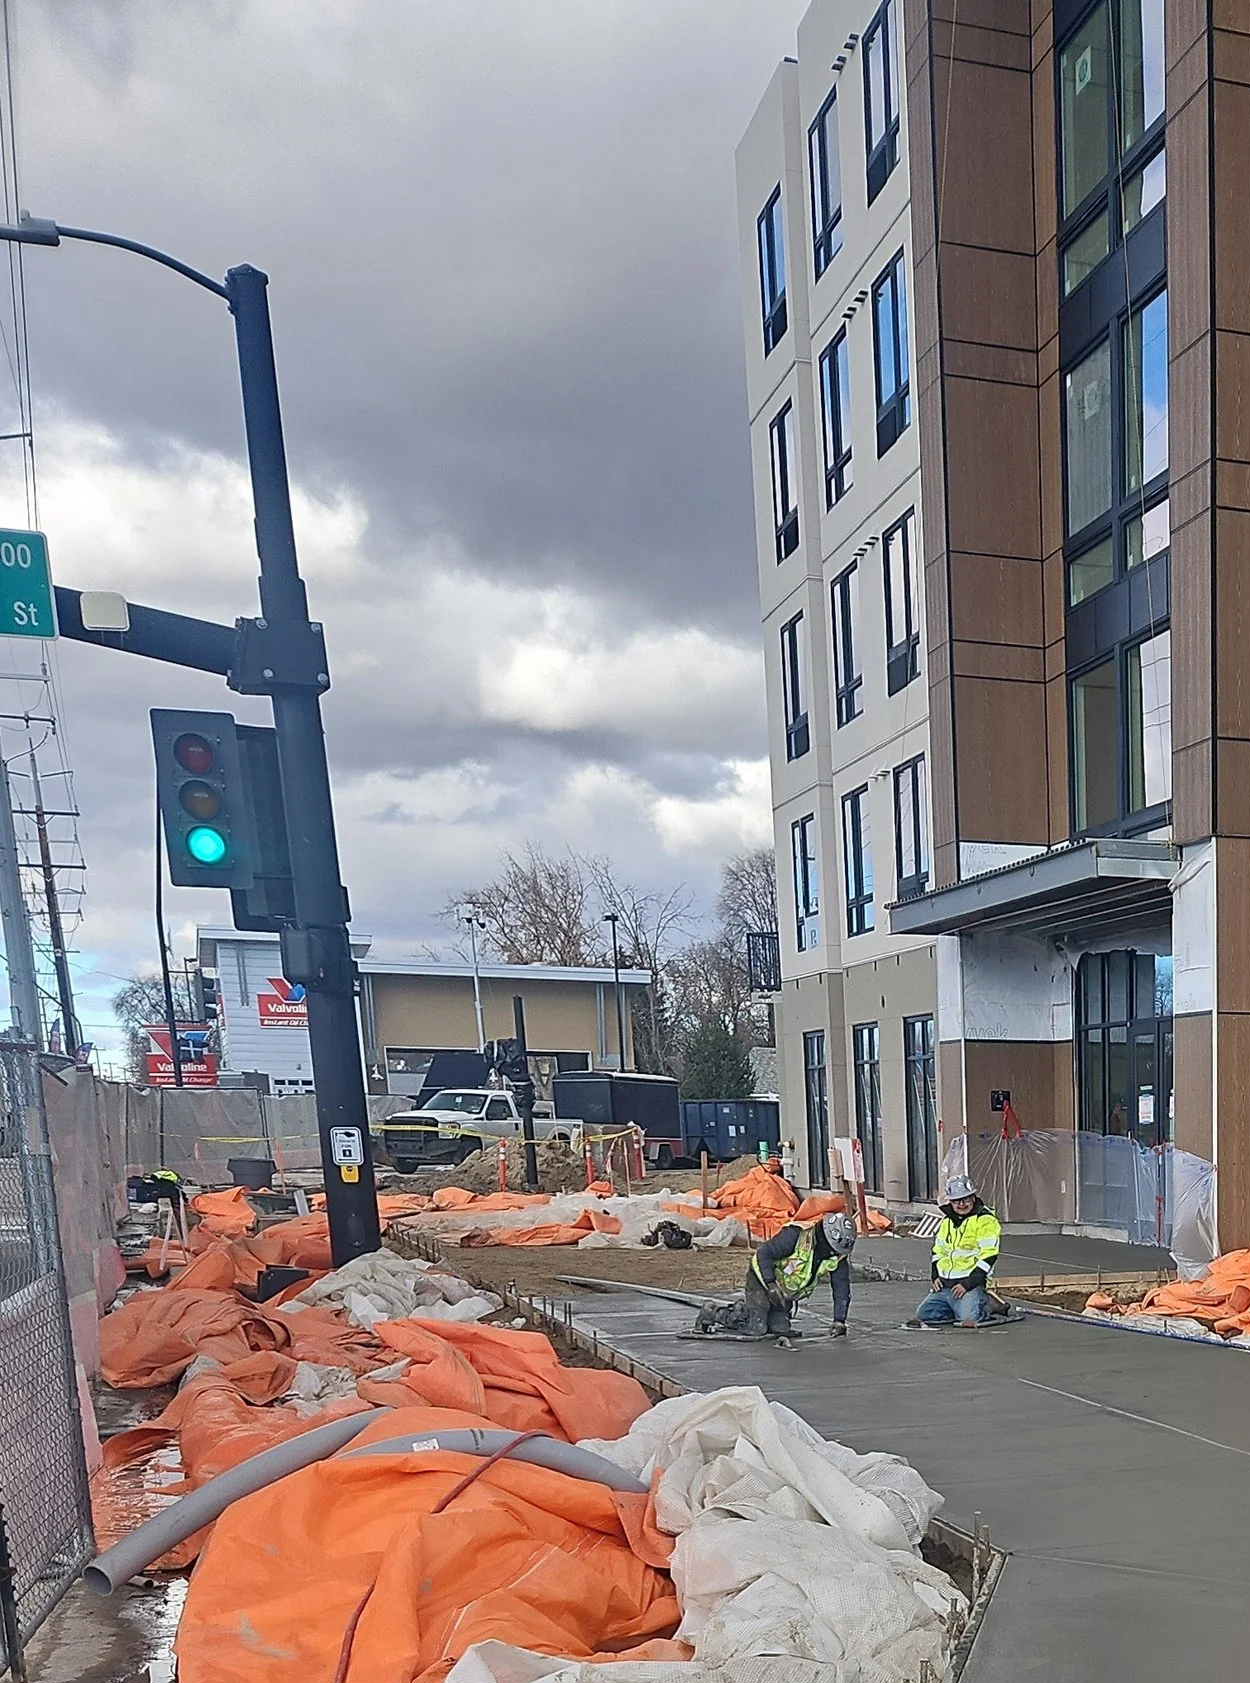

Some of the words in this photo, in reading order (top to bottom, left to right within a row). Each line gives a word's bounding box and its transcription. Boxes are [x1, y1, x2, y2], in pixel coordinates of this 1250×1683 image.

[1, 542, 31, 568] 00
[13, 601, 39, 626] St
[156, 1062, 208, 1072] Valoline
